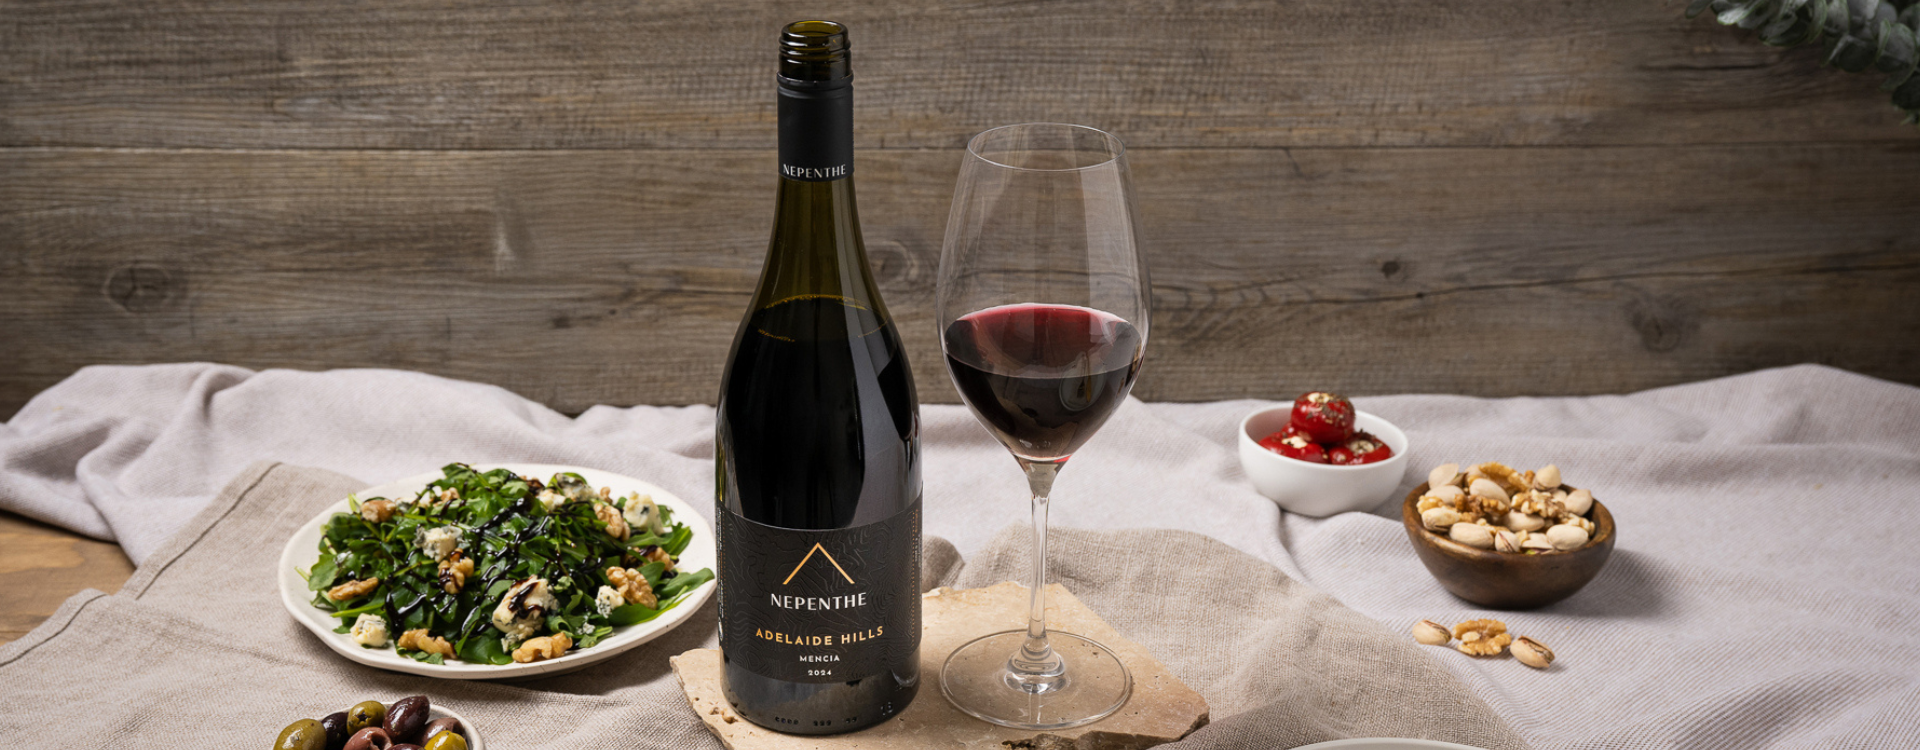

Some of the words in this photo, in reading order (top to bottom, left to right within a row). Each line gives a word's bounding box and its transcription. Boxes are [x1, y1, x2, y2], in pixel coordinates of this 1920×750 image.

[783, 163, 846, 178] NEPENTHE
[770, 592, 867, 611] NEPENTHE
[755, 627, 833, 646] ADELAIDE
[841, 625, 884, 645] HILLS
[799, 654, 841, 663] MENCIA
